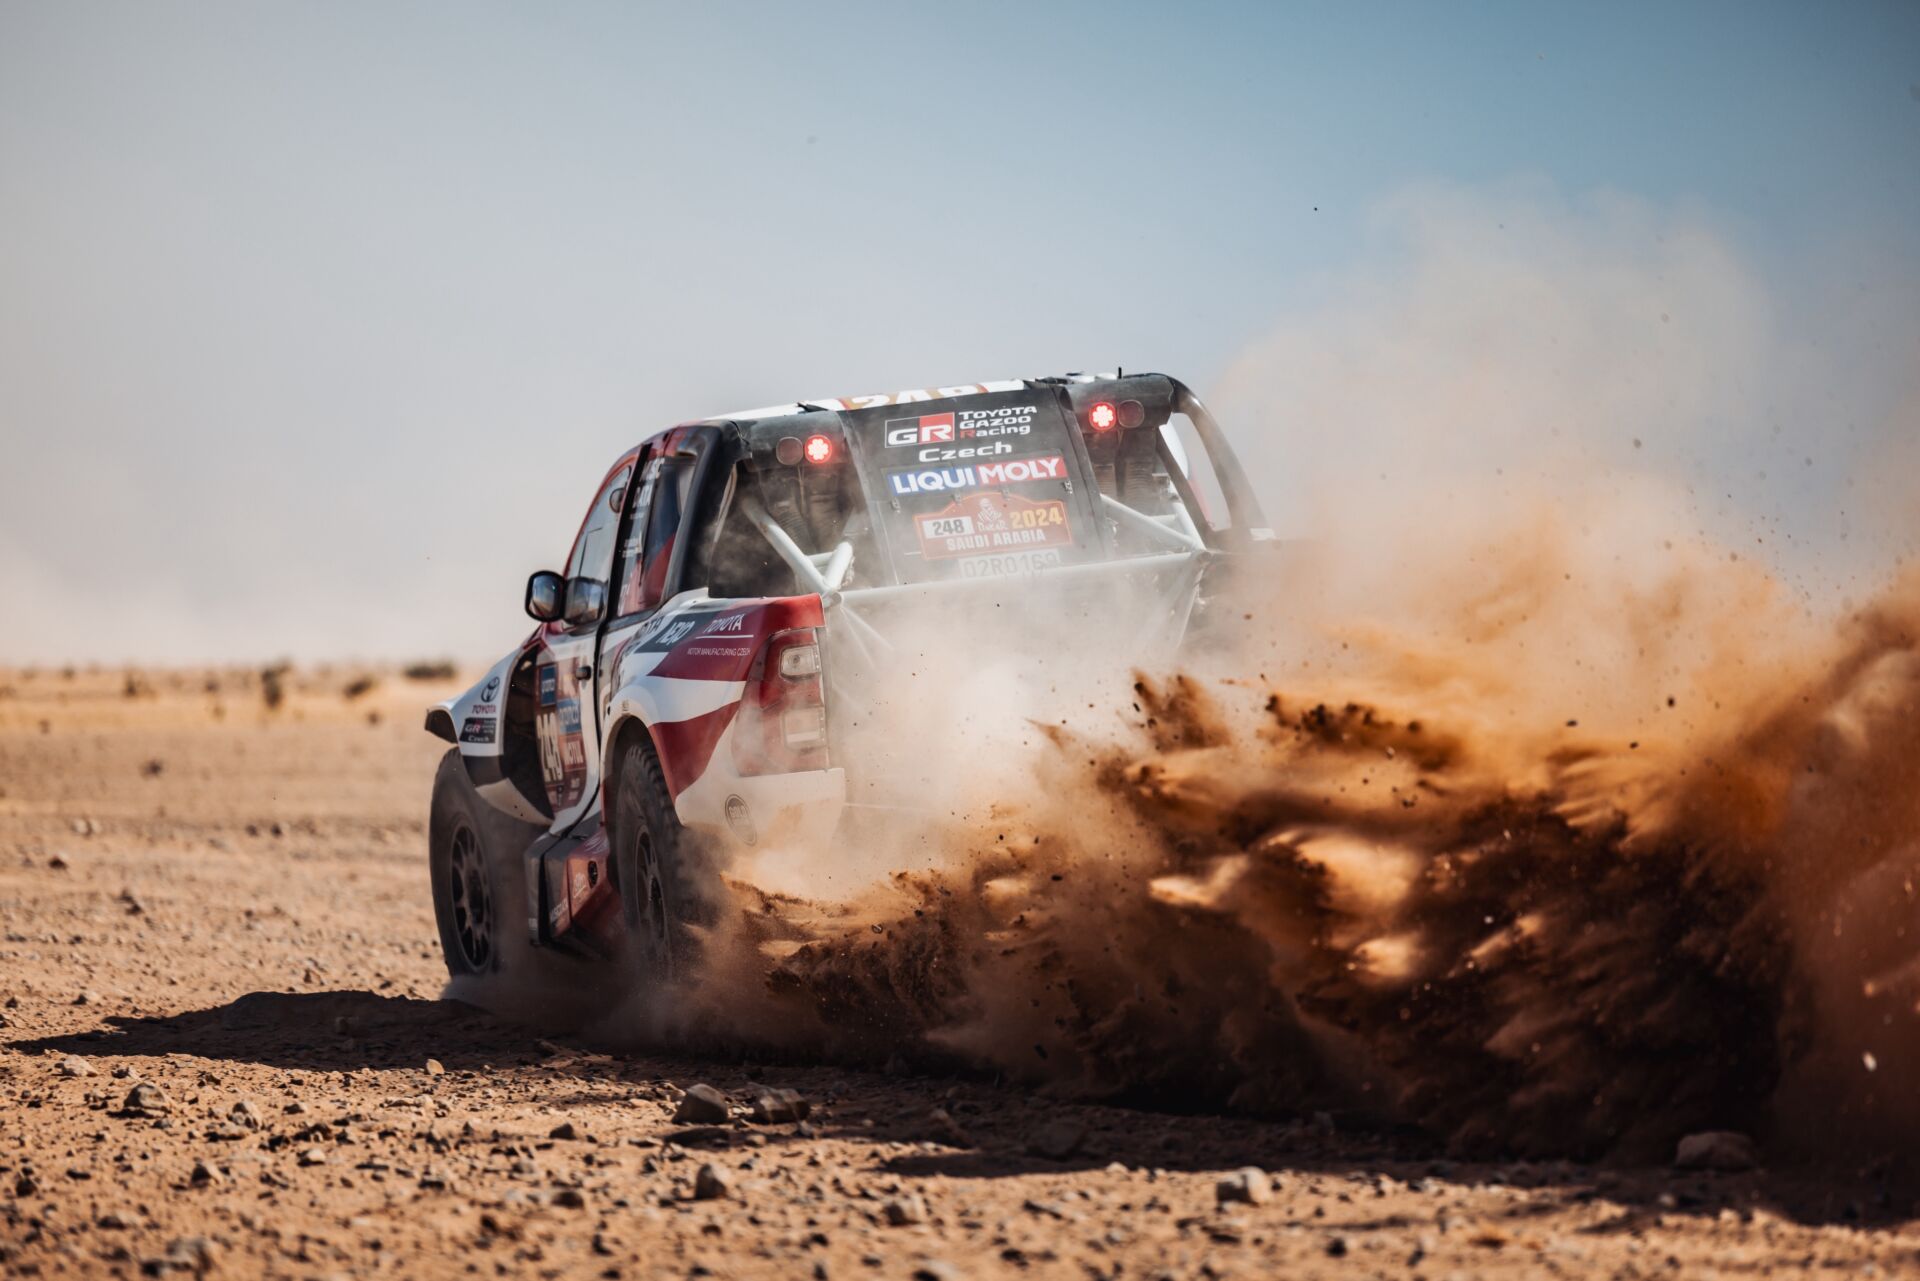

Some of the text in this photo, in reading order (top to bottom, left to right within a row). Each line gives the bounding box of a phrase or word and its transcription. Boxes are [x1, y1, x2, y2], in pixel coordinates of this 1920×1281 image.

[959, 406, 1038, 420] TOYOTA
[959, 415, 1032, 430] GAZOO
[888, 424, 953, 446] GR
[959, 424, 1031, 439] Racing
[919, 442, 1013, 463] Czech
[892, 457, 1060, 494] LIQUI MOLY
[932, 507, 1063, 537] 248 2024
[946, 529, 1046, 551] SAUDI ARABIA
[703, 614, 745, 633] TOYOTA
[472, 704, 497, 714] TOYOTA
